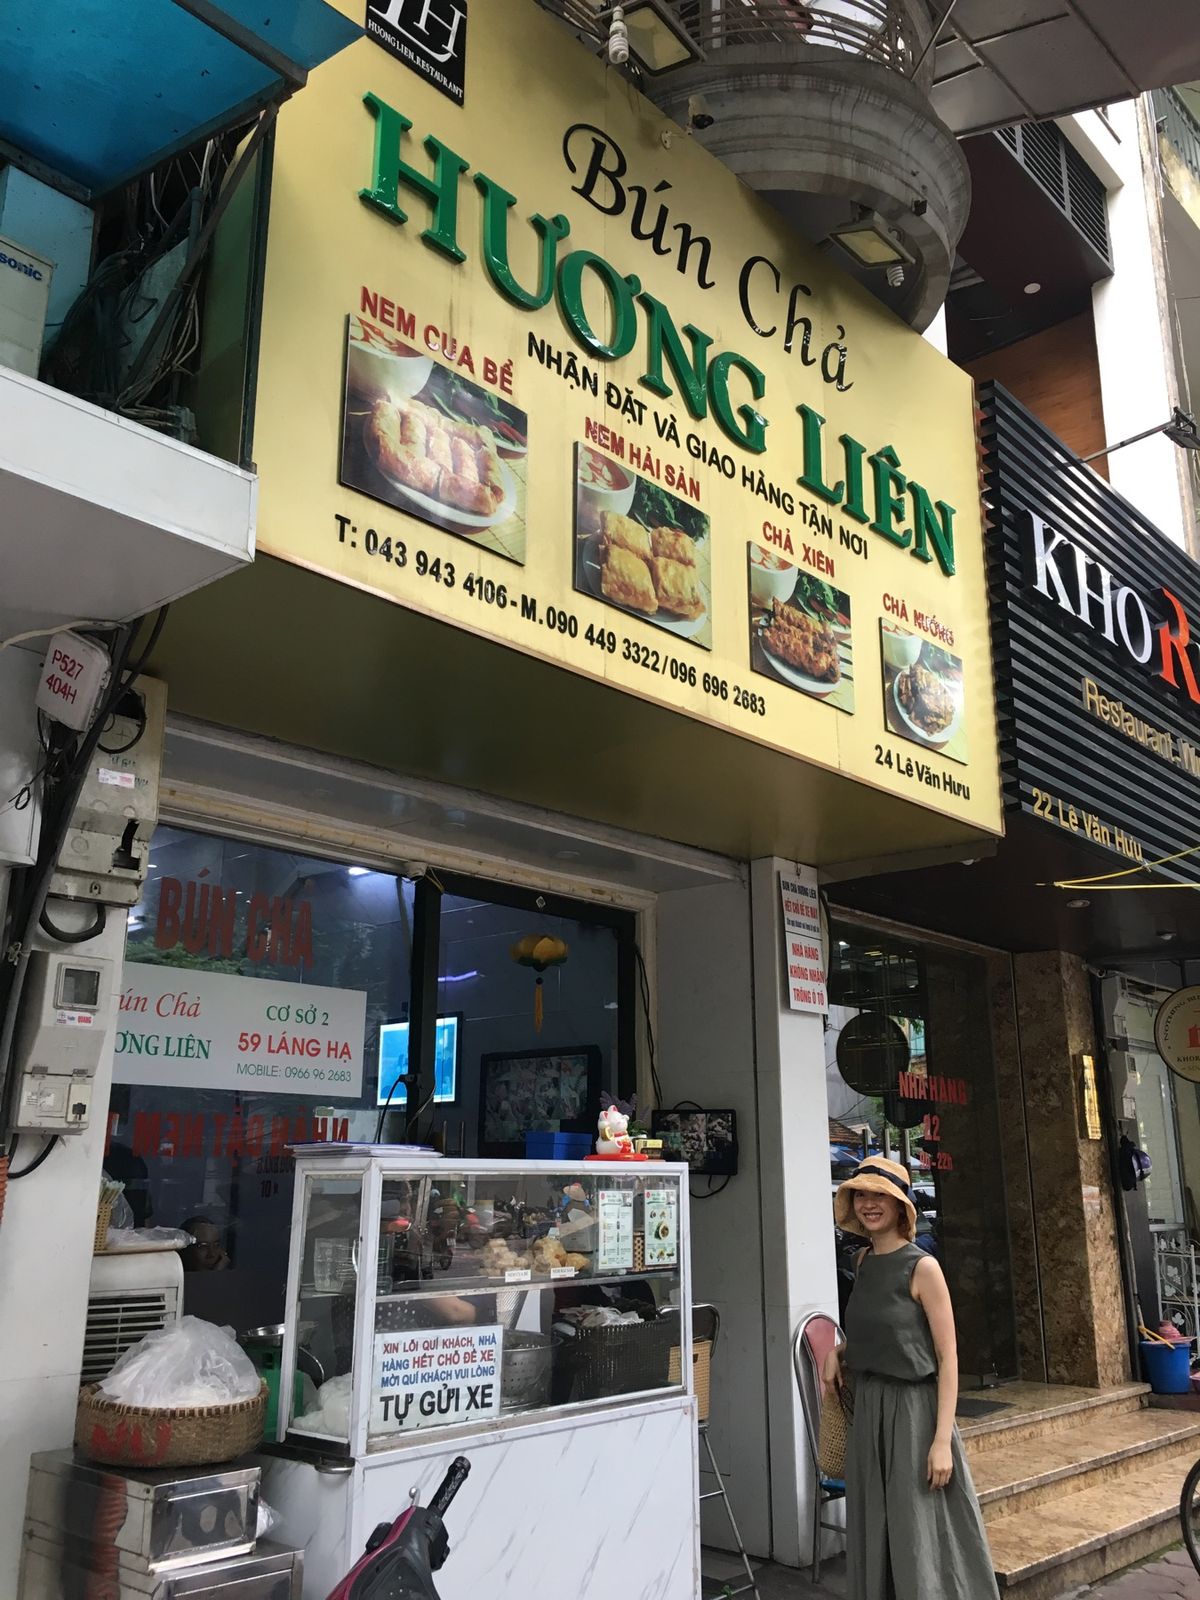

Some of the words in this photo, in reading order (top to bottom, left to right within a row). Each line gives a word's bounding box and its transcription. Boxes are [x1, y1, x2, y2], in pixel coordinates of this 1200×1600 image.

[563, 122, 716, 289] Bún
[738, 255, 854, 392] Chả
[357, 91, 769, 455] HƯƠNG
[796, 402, 957, 578] LIÊN
[360, 286, 415, 339] NEM
[424, 325, 475, 374] CUA
[483, 358, 513, 396] BỂ
[527, 331, 598, 397] NHẬN
[605, 382, 648, 425] ĐẶT
[654, 411, 681, 449] VÀ
[686, 433, 736, 480] GIAO
[741, 469, 795, 516] HÀNG
[799, 502, 834, 540] TẬN
[839, 525, 868, 560] NƠI
[584, 416, 624, 460] NEM
[629, 442, 661, 480] HẢI
[664, 466, 701, 502] SẢN
[762, 521, 794, 556] CHẢ
[801, 543, 835, 578] XIÊN
[335, 514, 357, 548] T:
[365, 529, 407, 568] 043
[415, 550, 456, 588] 943
[585, 624, 616, 654] 449
[703, 673, 728, 701] 696
[733, 685, 766, 716] 2683
[882, 593, 908, 622] CHẢ
[1024, 508, 1200, 705] KHOR
[45, 673, 78, 704] 404H
[51, 648, 84, 681] P527
[1082, 676, 1173, 763] Restaurant
[875, 744, 893, 770] 24
[896, 753, 914, 778] Lê
[915, 761, 941, 790] Văn
[943, 771, 970, 801] Hưu
[1032, 787, 1054, 821] 22
[1058, 798, 1079, 832] Lê
[1081, 810, 1111, 847] Văn
[154, 868, 237, 959] BÚN
[119, 988, 148, 1012] ún
[155, 992, 201, 1018] Chả
[266, 1004, 291, 1022] CƠ
[295, 1004, 317, 1025] SỞ
[321, 1012, 329, 1026] 2
[115, 1030, 160, 1056] ƠNG
[164, 1033, 212, 1059] LIÊN
[238, 1032, 261, 1052] 59
[267, 1030, 321, 1057] LÁNG
[327, 1040, 352, 1063] HẠ
[236, 1063, 281, 1077] MOBILE:
[284, 1066, 310, 1079] 0966
[313, 1068, 325, 1081] 96
[327, 1069, 352, 1082] 2683
[382, 1358, 409, 1372] HÀNG
[412, 1353, 434, 1369] HẾT
[437, 1350, 460, 1367] CHỖ
[463, 1348, 477, 1364] ĐỂ
[383, 1343, 399, 1354] XIN
[403, 1339, 419, 1353] LỖI
[422, 1337, 438, 1352] QUÍ
[442, 1336, 475, 1349] KHÁCH,
[478, 1333, 497, 1346] NHÀ
[381, 1375, 400, 1388] MỜI
[421, 1369, 452, 1383] KHÁCH
[454, 1368, 469, 1379] VUI
[471, 1365, 495, 1378] LÒNG
[380, 1393, 414, 1426] TỰ
[420, 1383, 460, 1416] GỬI
[465, 1384, 493, 1410] XE
